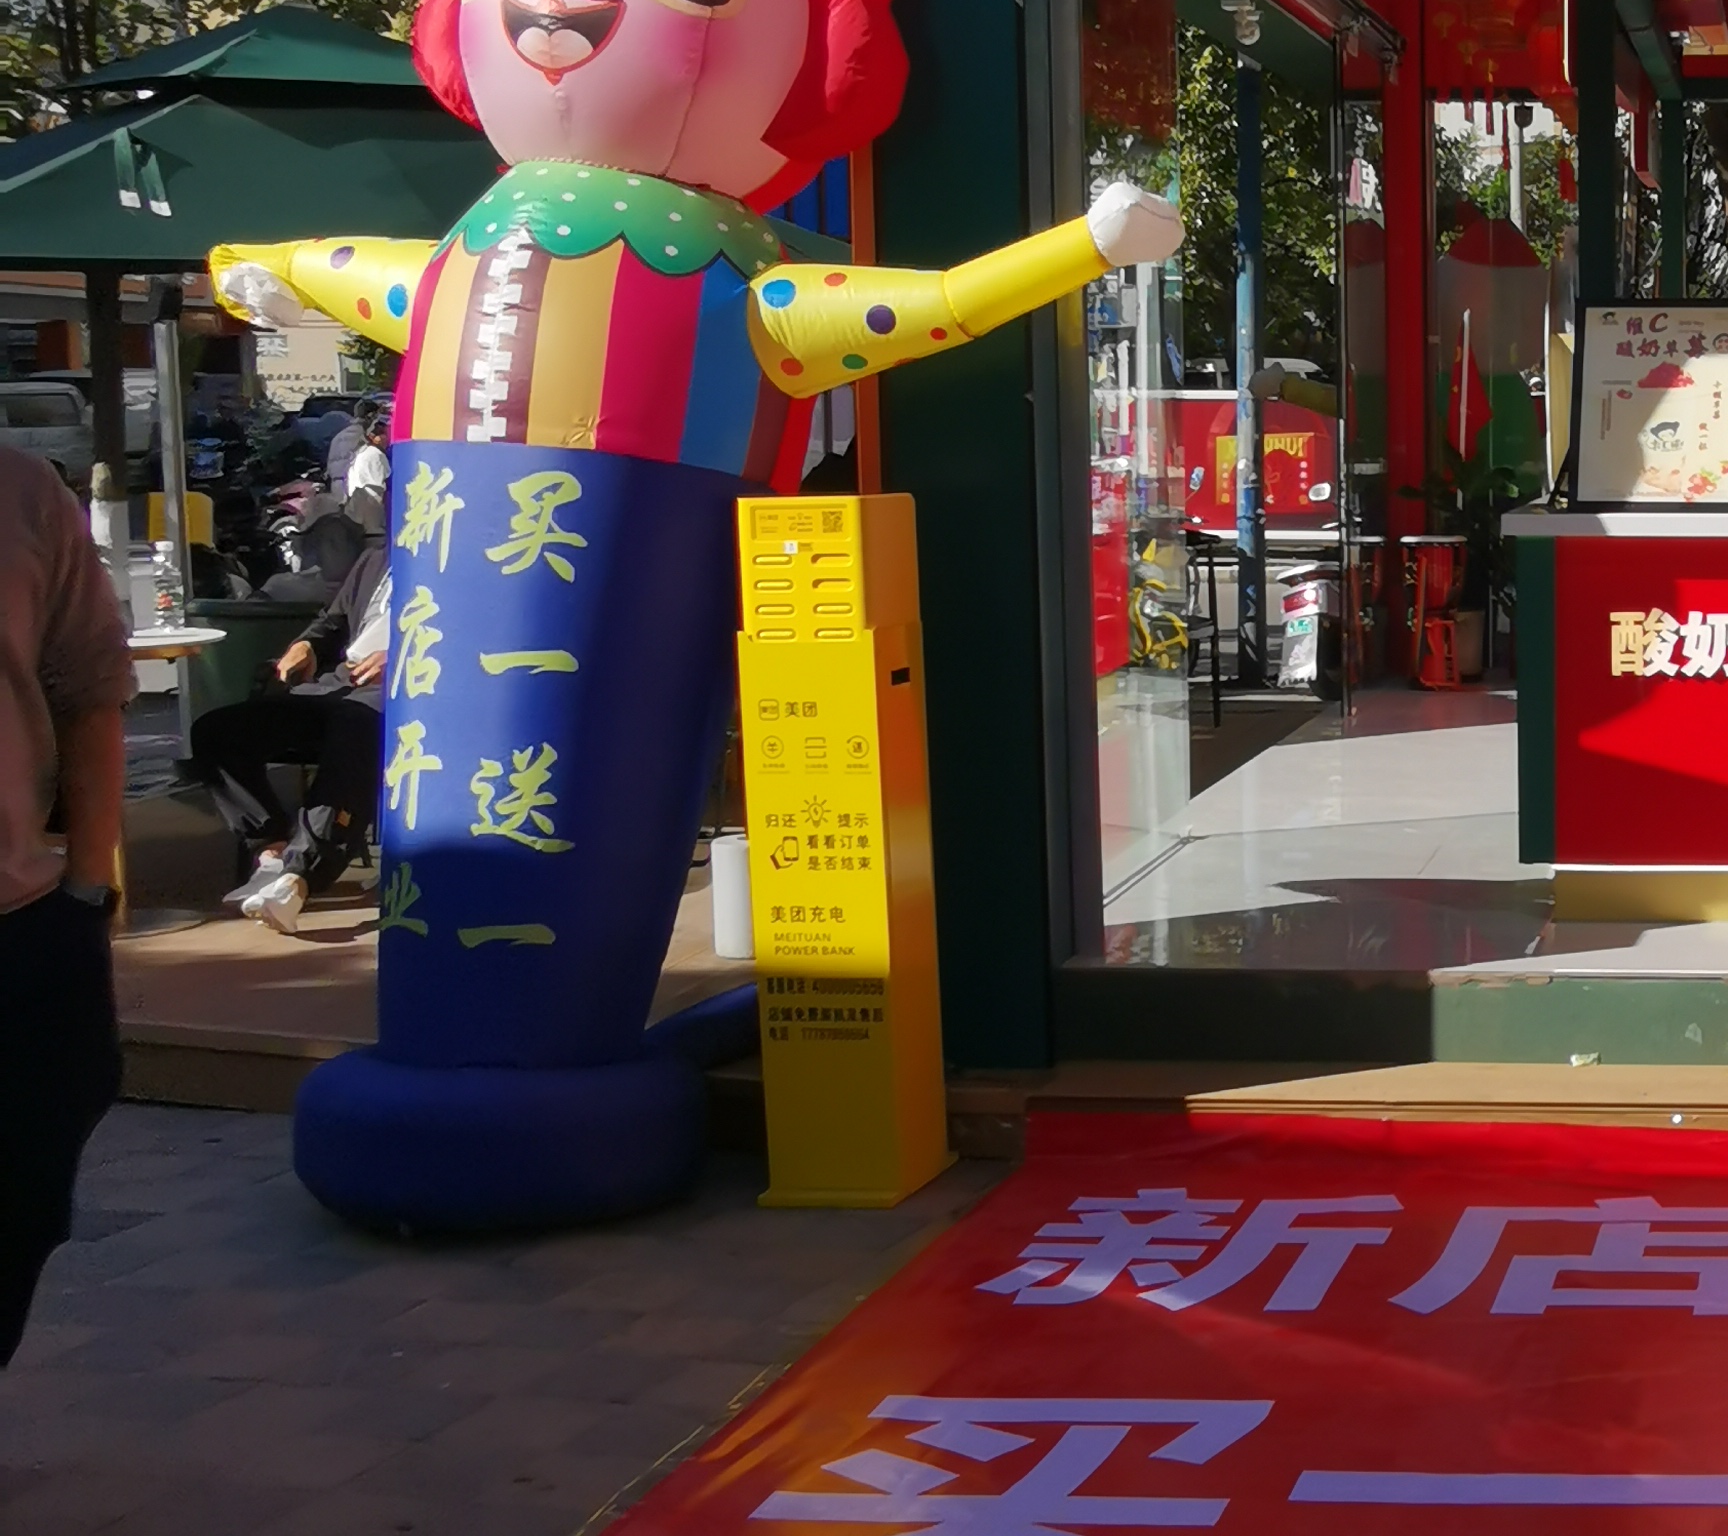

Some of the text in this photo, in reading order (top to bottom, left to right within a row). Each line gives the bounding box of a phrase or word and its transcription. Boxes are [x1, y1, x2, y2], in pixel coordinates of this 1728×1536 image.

[380, 461, 465, 938] 新店开业
[457, 470, 588, 949] 买一送一
[785, 701, 818, 718] 美团
[765, 813, 869, 828] 归还 提示
[807, 834, 871, 850] 看看订单
[808, 855, 872, 871] 是否结束
[770, 906, 846, 923] 美团充电
[774, 932, 832, 942] MEITUAN
[775, 946, 856, 955] POWER BANK
